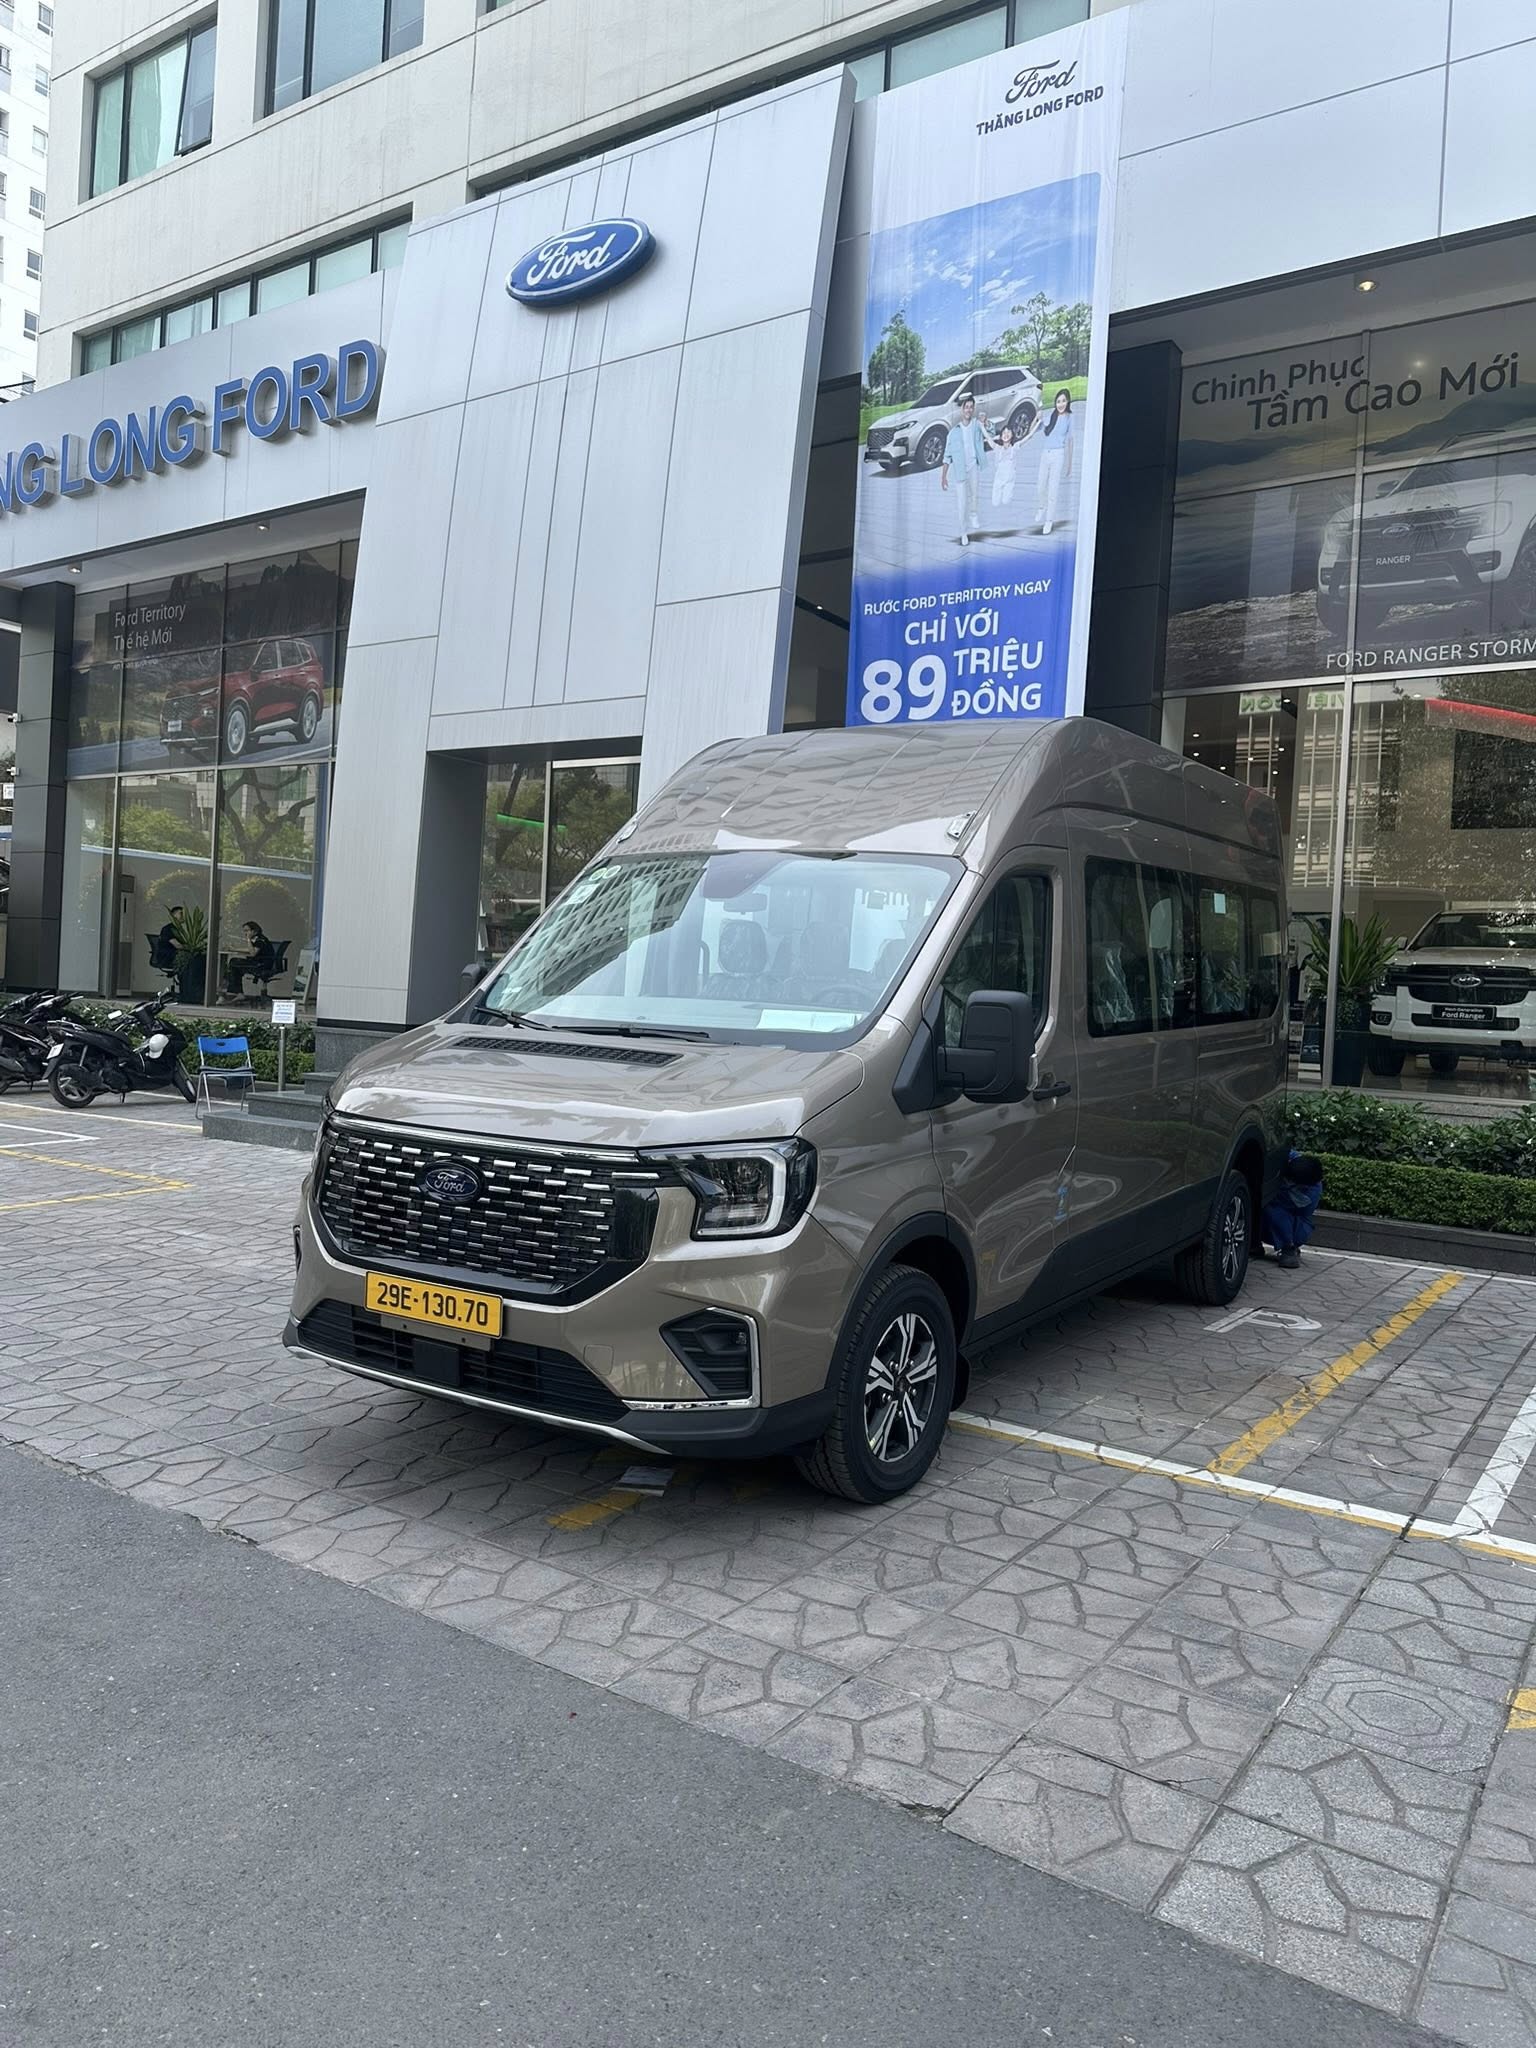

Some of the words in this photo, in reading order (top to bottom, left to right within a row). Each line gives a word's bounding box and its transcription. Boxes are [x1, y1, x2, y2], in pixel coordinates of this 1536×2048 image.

[1005, 59, 1078, 104] Ford
[976, 111, 1024, 136] THĂNG
[1025, 98, 1063, 121] LONG
[1065, 85, 1104, 109] FORD
[526, 230, 617, 287] Ford
[1191, 368, 1276, 405] Chinh
[1288, 355, 1365, 387] Phục
[1247, 389, 1329, 430] Tầm
[1345, 379, 1422, 414] Cao
[1439, 351, 1519, 400] Mới
[60, 394, 198, 496] LONG
[211, 338, 379, 453] FORD
[1375, 555, 1411, 566] RANGER
[115, 608, 138, 628] Ford
[140, 604, 186, 623] Territory
[864, 600, 900, 616] RƯỚC
[903, 596, 937, 612] FORD
[940, 585, 1011, 606] TERRITORY
[1014, 579, 1051, 596] NGAY
[114, 631, 134, 651] Thế
[135, 630, 149, 650] hệ
[151, 627, 173, 645] Mới
[904, 611, 947, 646] CHỈ
[955, 607, 999, 639] VỚI
[1326, 652, 1377, 669] FORD
[1383, 643, 1462, 665] RANGER
[1467, 638, 1536, 659] STORM
[860, 654, 947, 723] 89
[953, 637, 1044, 680] TRIỆU
[951, 678, 1042, 717] ĐỒNG
[1459, 1012, 1486, 1020] Ranger
[434, 1171, 466, 1193] Ford
[377, 1281, 489, 1327] 29E-130.70
